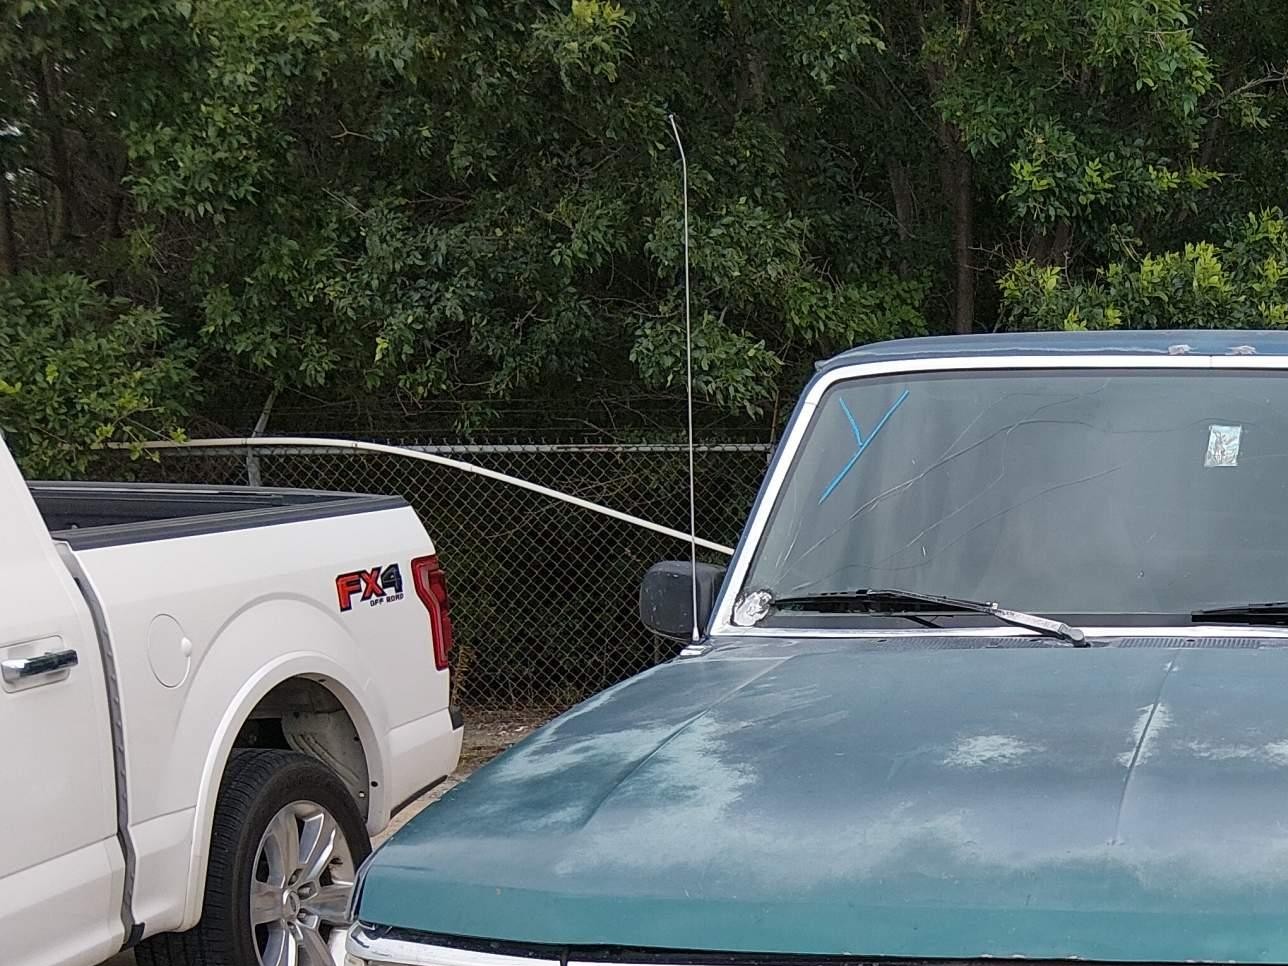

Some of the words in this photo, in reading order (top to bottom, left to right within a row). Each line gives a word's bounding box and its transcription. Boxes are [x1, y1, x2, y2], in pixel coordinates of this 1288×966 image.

[818, 389, 910, 505] Y
[335, 563, 403, 612] FX4
[370, 598, 385, 607] OFF
[386, 592, 404, 603] ROAD
